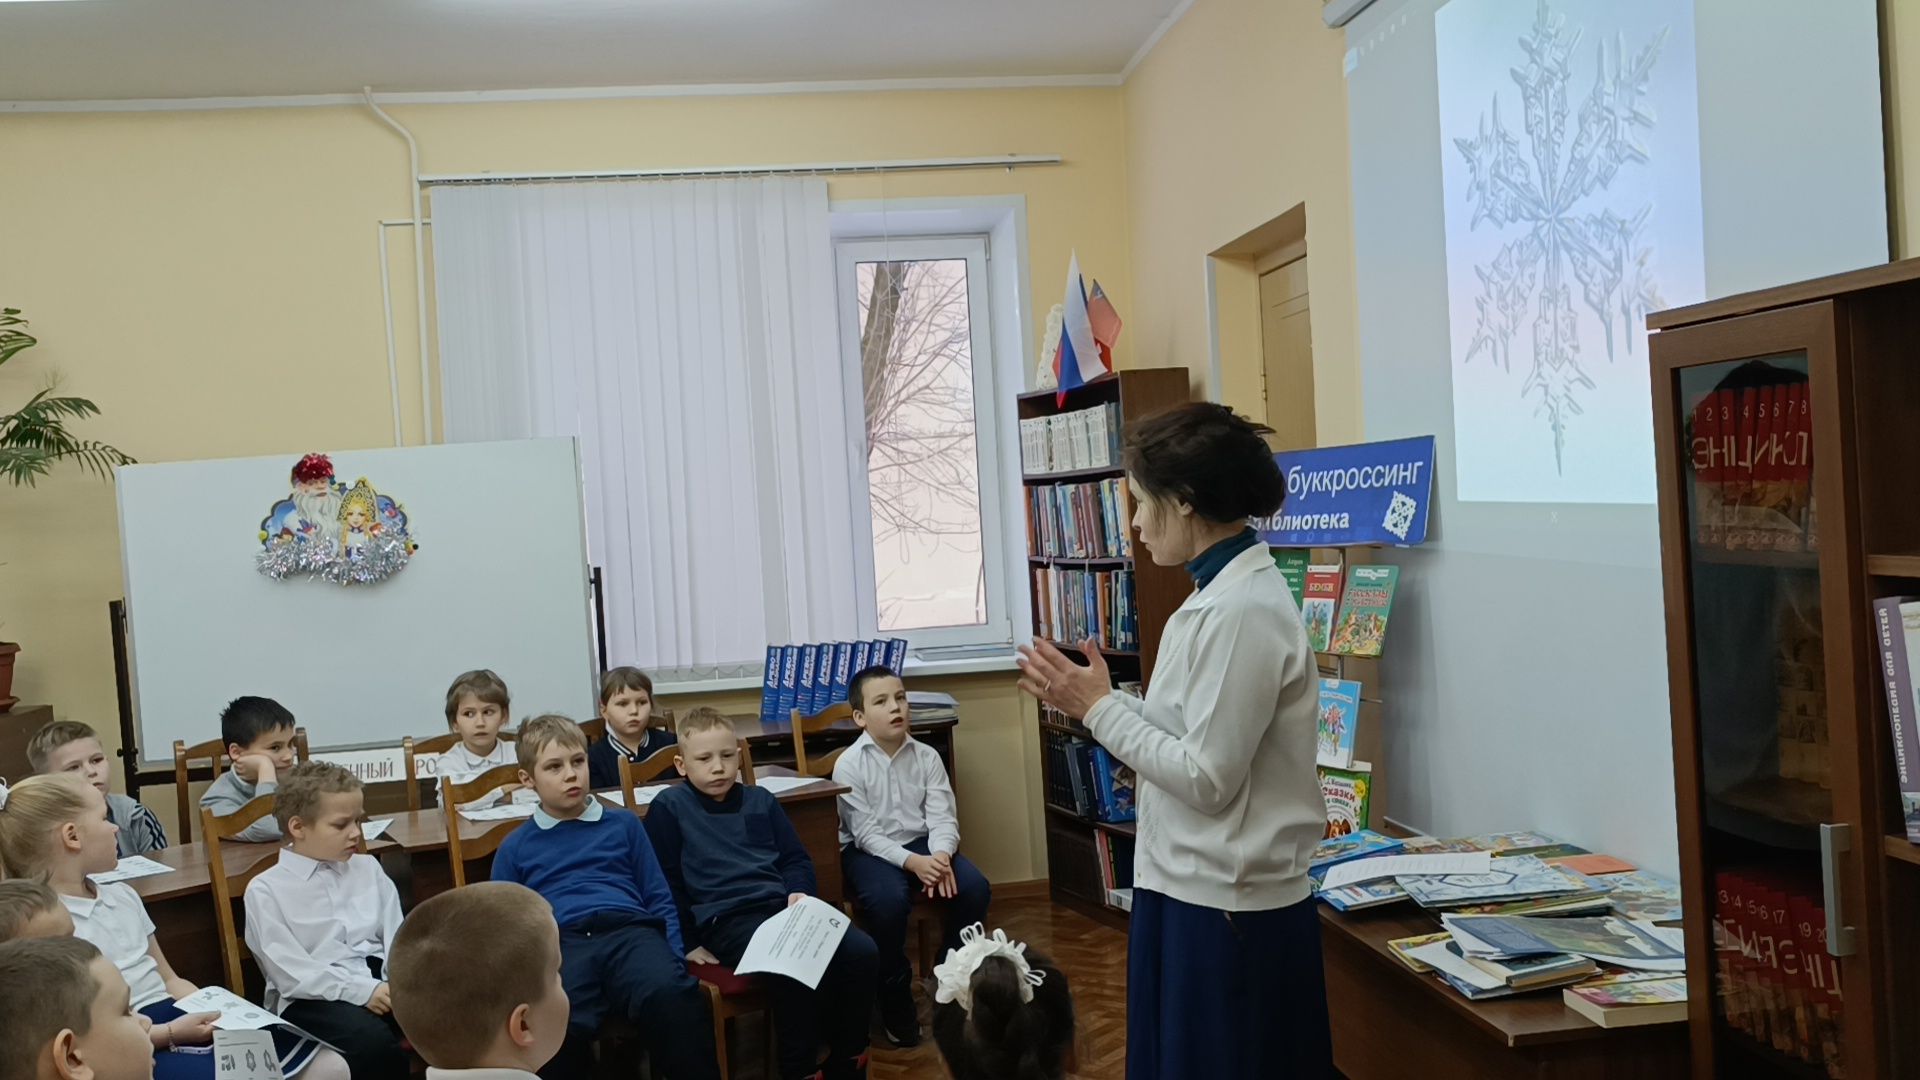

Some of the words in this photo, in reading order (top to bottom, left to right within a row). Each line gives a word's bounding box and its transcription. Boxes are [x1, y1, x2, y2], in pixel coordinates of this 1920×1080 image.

[1705, 407, 1713, 421] 2
[1722, 406, 1729, 420] 3
[1743, 405, 1749, 419] 4
[1758, 403, 1766, 418] 5
[1774, 402, 1780, 417] 6
[1788, 400, 1795, 415] 7
[1800, 399, 1807, 415] 8
[1287, 461, 1423, 500] буккроссинг
[1256, 508, 1350, 531] иблиотека
[1773, 910, 1785, 924] 17
[1798, 921, 1812, 937] 19
